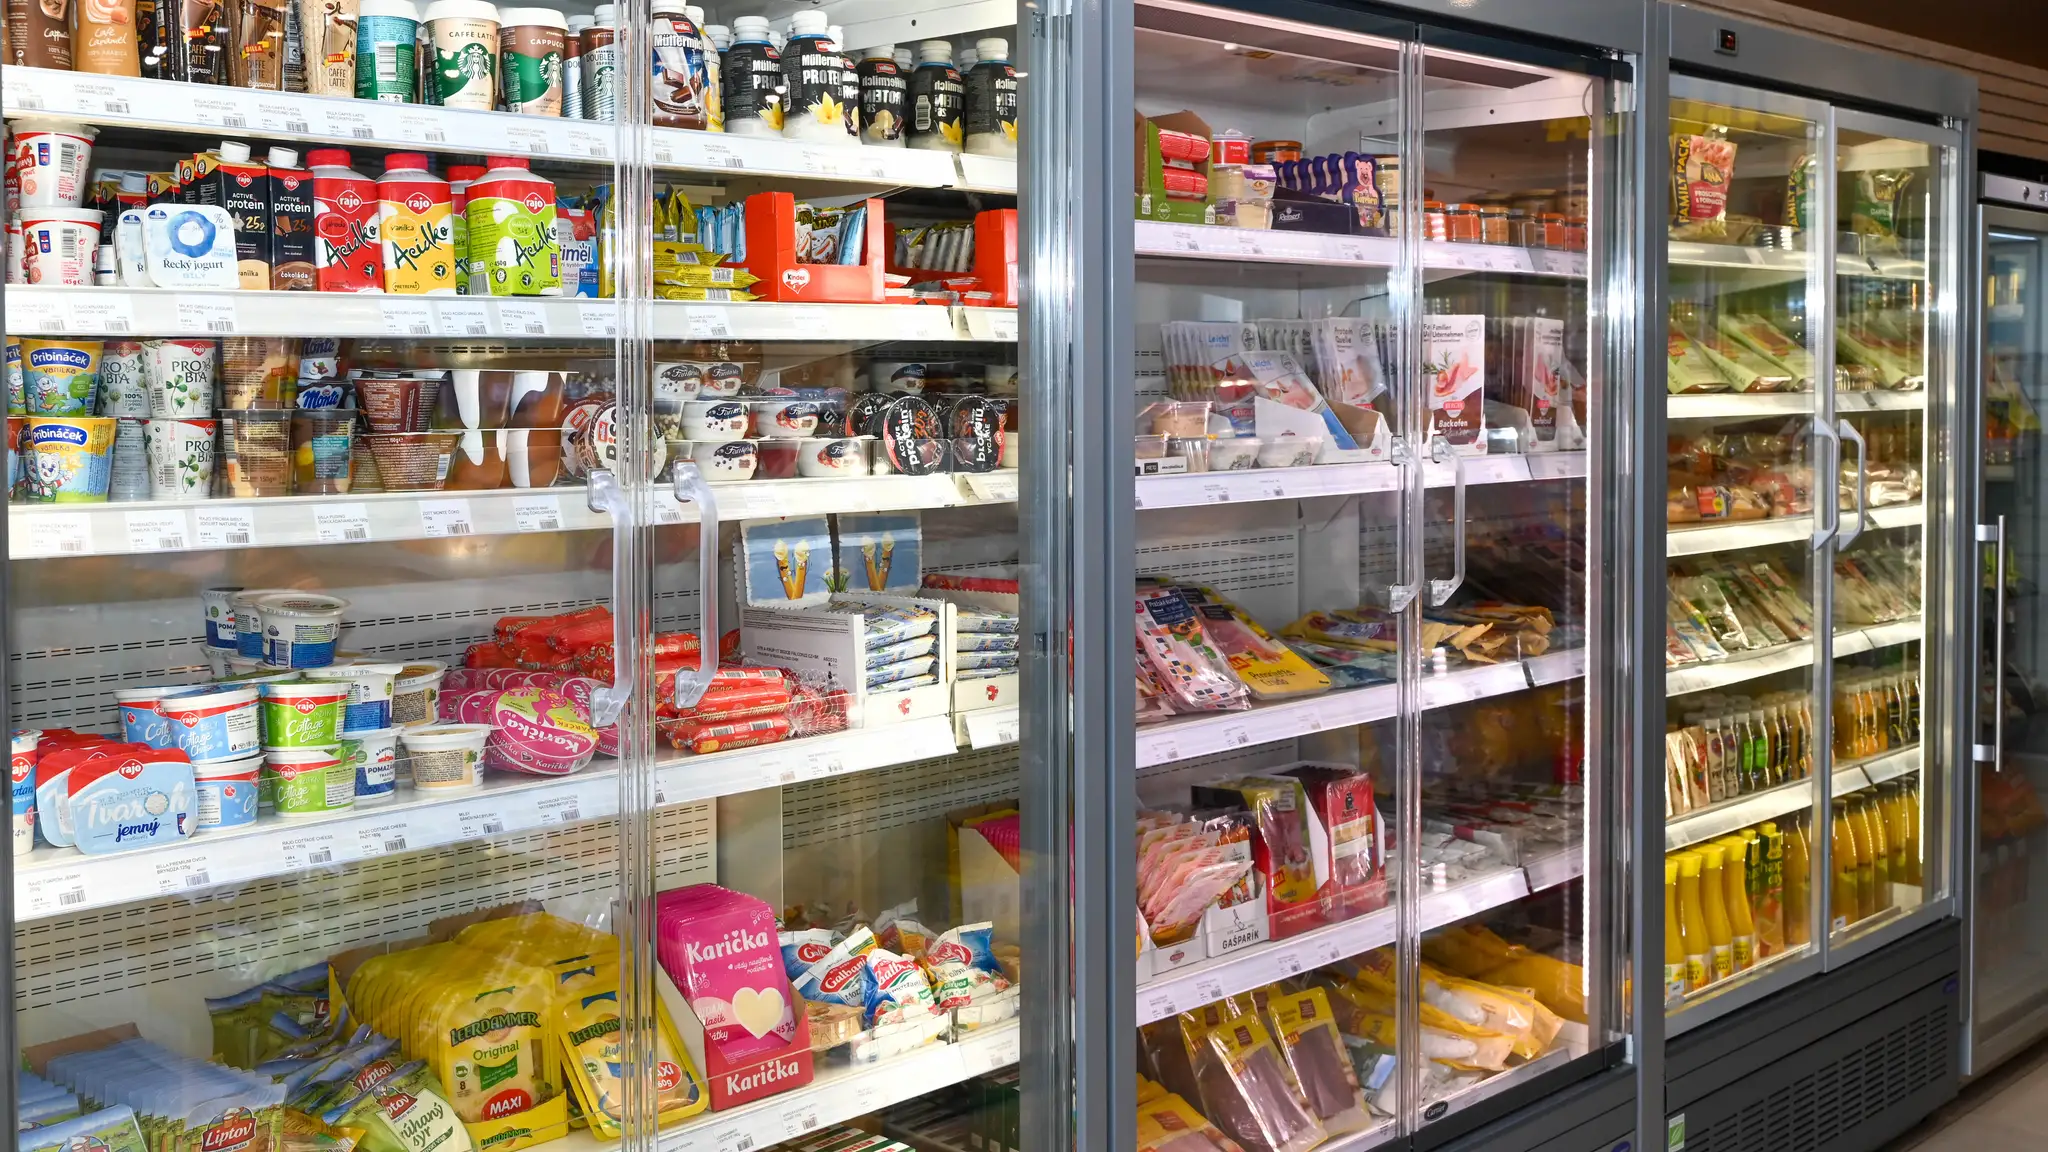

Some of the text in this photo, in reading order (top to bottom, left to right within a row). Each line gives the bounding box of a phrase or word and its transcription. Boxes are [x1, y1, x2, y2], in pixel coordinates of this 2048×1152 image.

[245, 45, 264, 53] BILLA
[327, 54, 345, 63] BILLA
[329, 67, 346, 78] CAFFE
[329, 78, 346, 89] LATTE
[236, 175, 252, 184] rajo
[284, 179, 298, 188] rajo
[1677, 138, 1690, 223] FAMILY PACK
[227, 199, 265, 211] protein
[274, 202, 311, 213] protein
[339, 197, 360, 209] rajo
[408, 198, 430, 210] rajo
[523, 197, 543, 210] rajo
[390, 223, 415, 232] vanilka
[324, 219, 378, 270] Acidko
[391, 220, 450, 271] Acidko
[514, 218, 558, 270] Acidko
[163, 258, 224, 271] Řecký jogurt
[280, 270, 309, 279] čokoláda
[1208, 334, 1231, 343] Leicht
[32, 349, 88, 366] Pribináček
[171, 360, 201, 372] PRO
[303, 390, 339, 409] Monte
[1438, 419, 1469, 428] Backofen
[33, 428, 83, 443] Pribináček
[900, 409, 921, 466] protein
[297, 702, 315, 712] rajo
[182, 717, 198, 726] rajo
[286, 717, 326, 737] Cottage
[506, 717, 580, 754] Karička
[120, 763, 142, 775] rajo
[535, 758, 569, 770] Karička
[281, 768, 296, 778] rajo
[277, 784, 311, 803] Cottage
[115, 816, 160, 843] jemný
[1222, 929, 1260, 950] GAŠPARÍK
[685, 927, 770, 966] Karička
[824, 957, 868, 990] Galbani
[450, 1011, 541, 1047] LEERDAMMER
[775, 1020, 796, 1034] 45%
[472, 1039, 520, 1062] Original
[358, 1062, 393, 1092] Liptov
[726, 1059, 799, 1096] Karička
[459, 1080, 467, 1091] 8
[489, 1095, 522, 1116] MAXI
[205, 1122, 253, 1147] Liptov
[412, 1124, 432, 1148] syr
